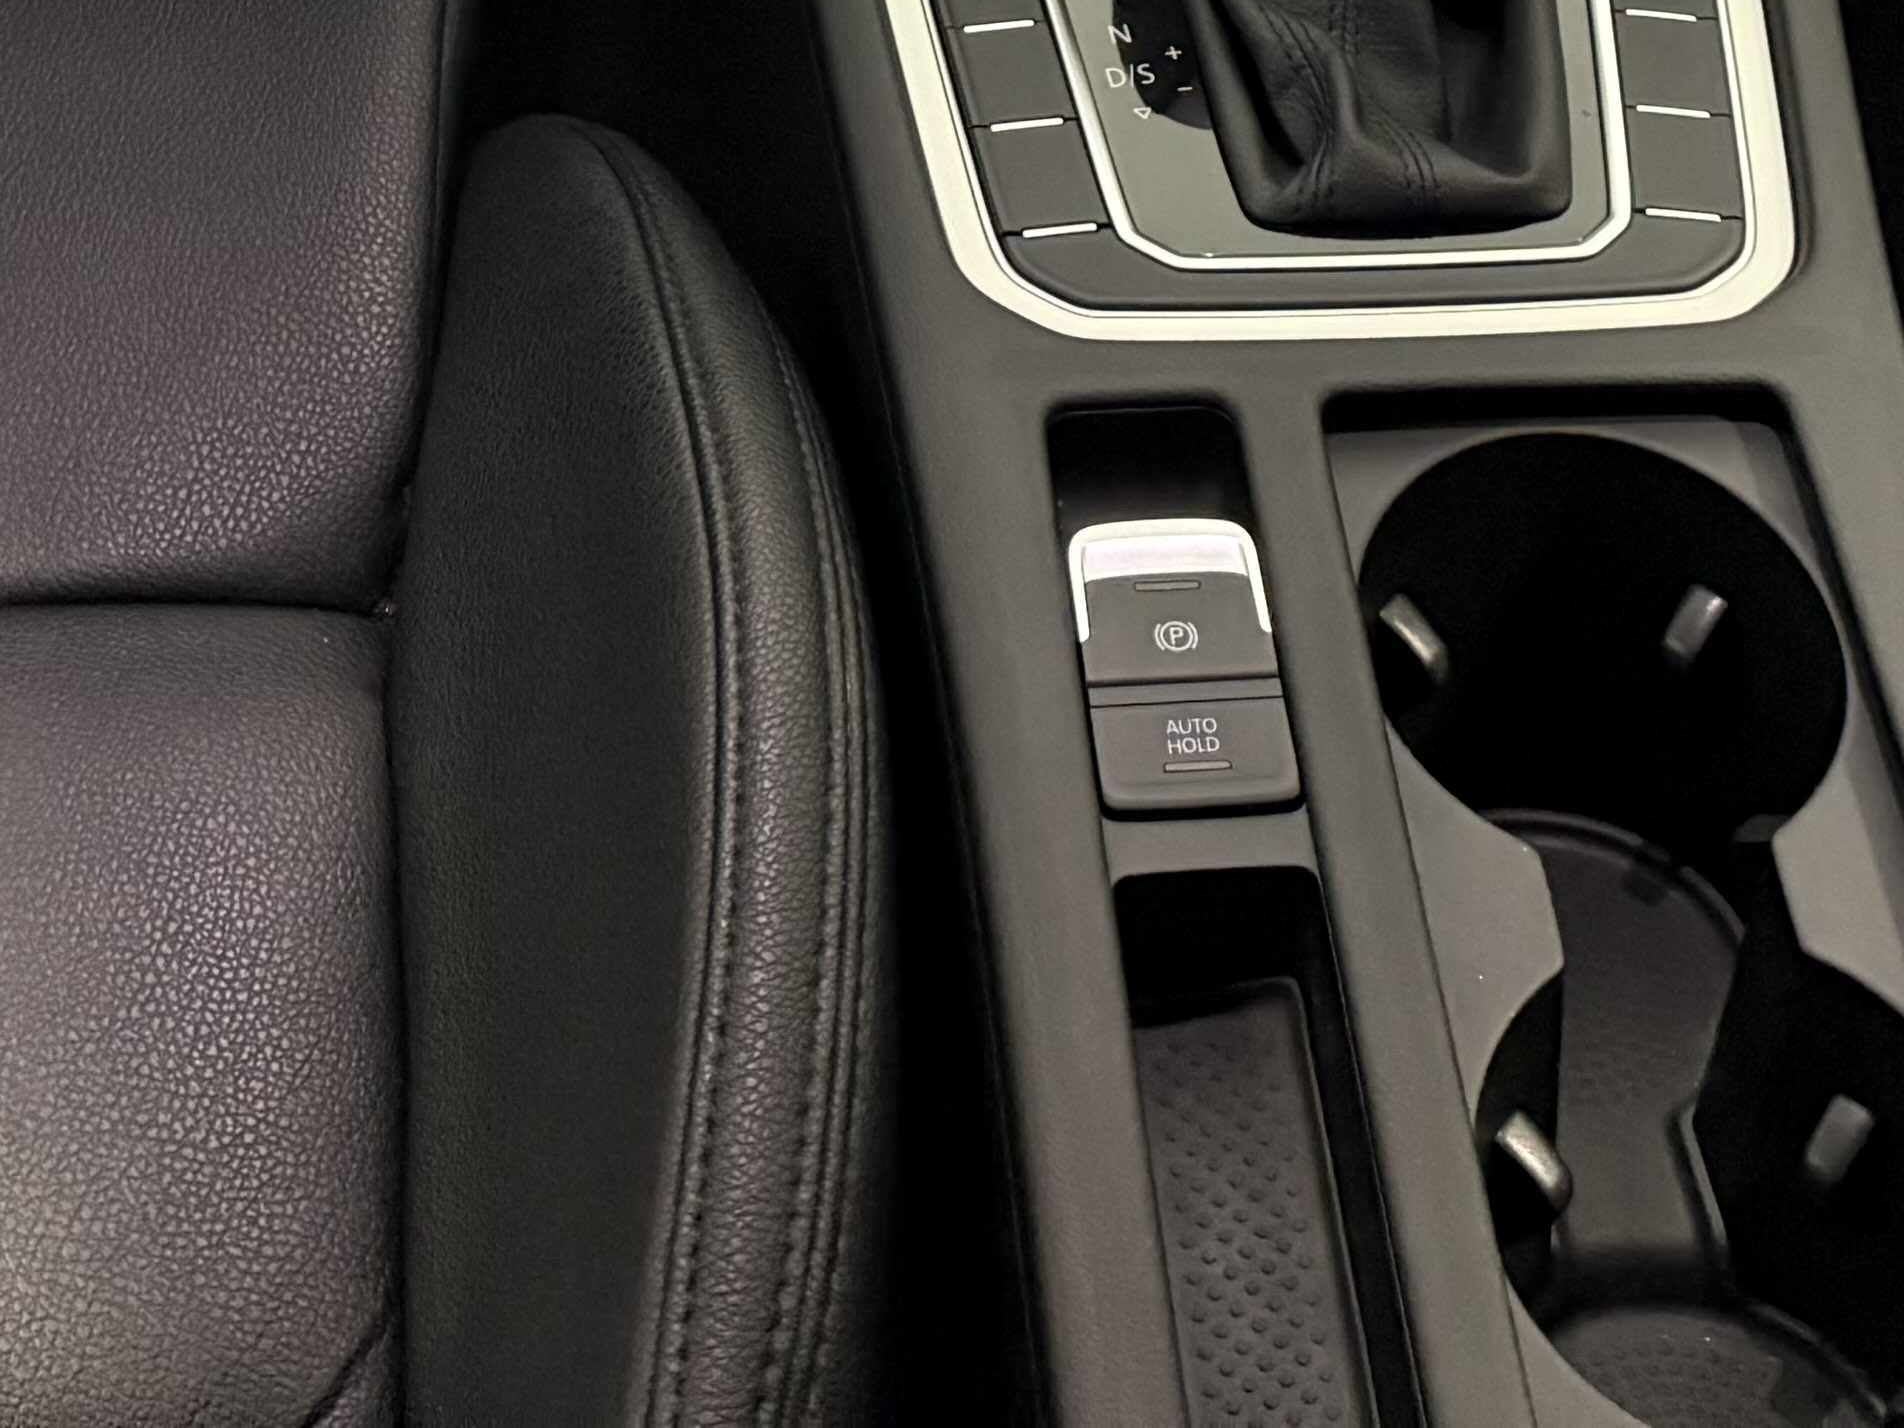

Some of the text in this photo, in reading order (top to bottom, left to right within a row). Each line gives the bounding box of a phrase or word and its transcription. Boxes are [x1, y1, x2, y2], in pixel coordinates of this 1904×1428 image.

[1108, 24, 1132, 44] N
[1166, 718, 1218, 735] AUTO
[1167, 737, 1221, 755] HOLD
